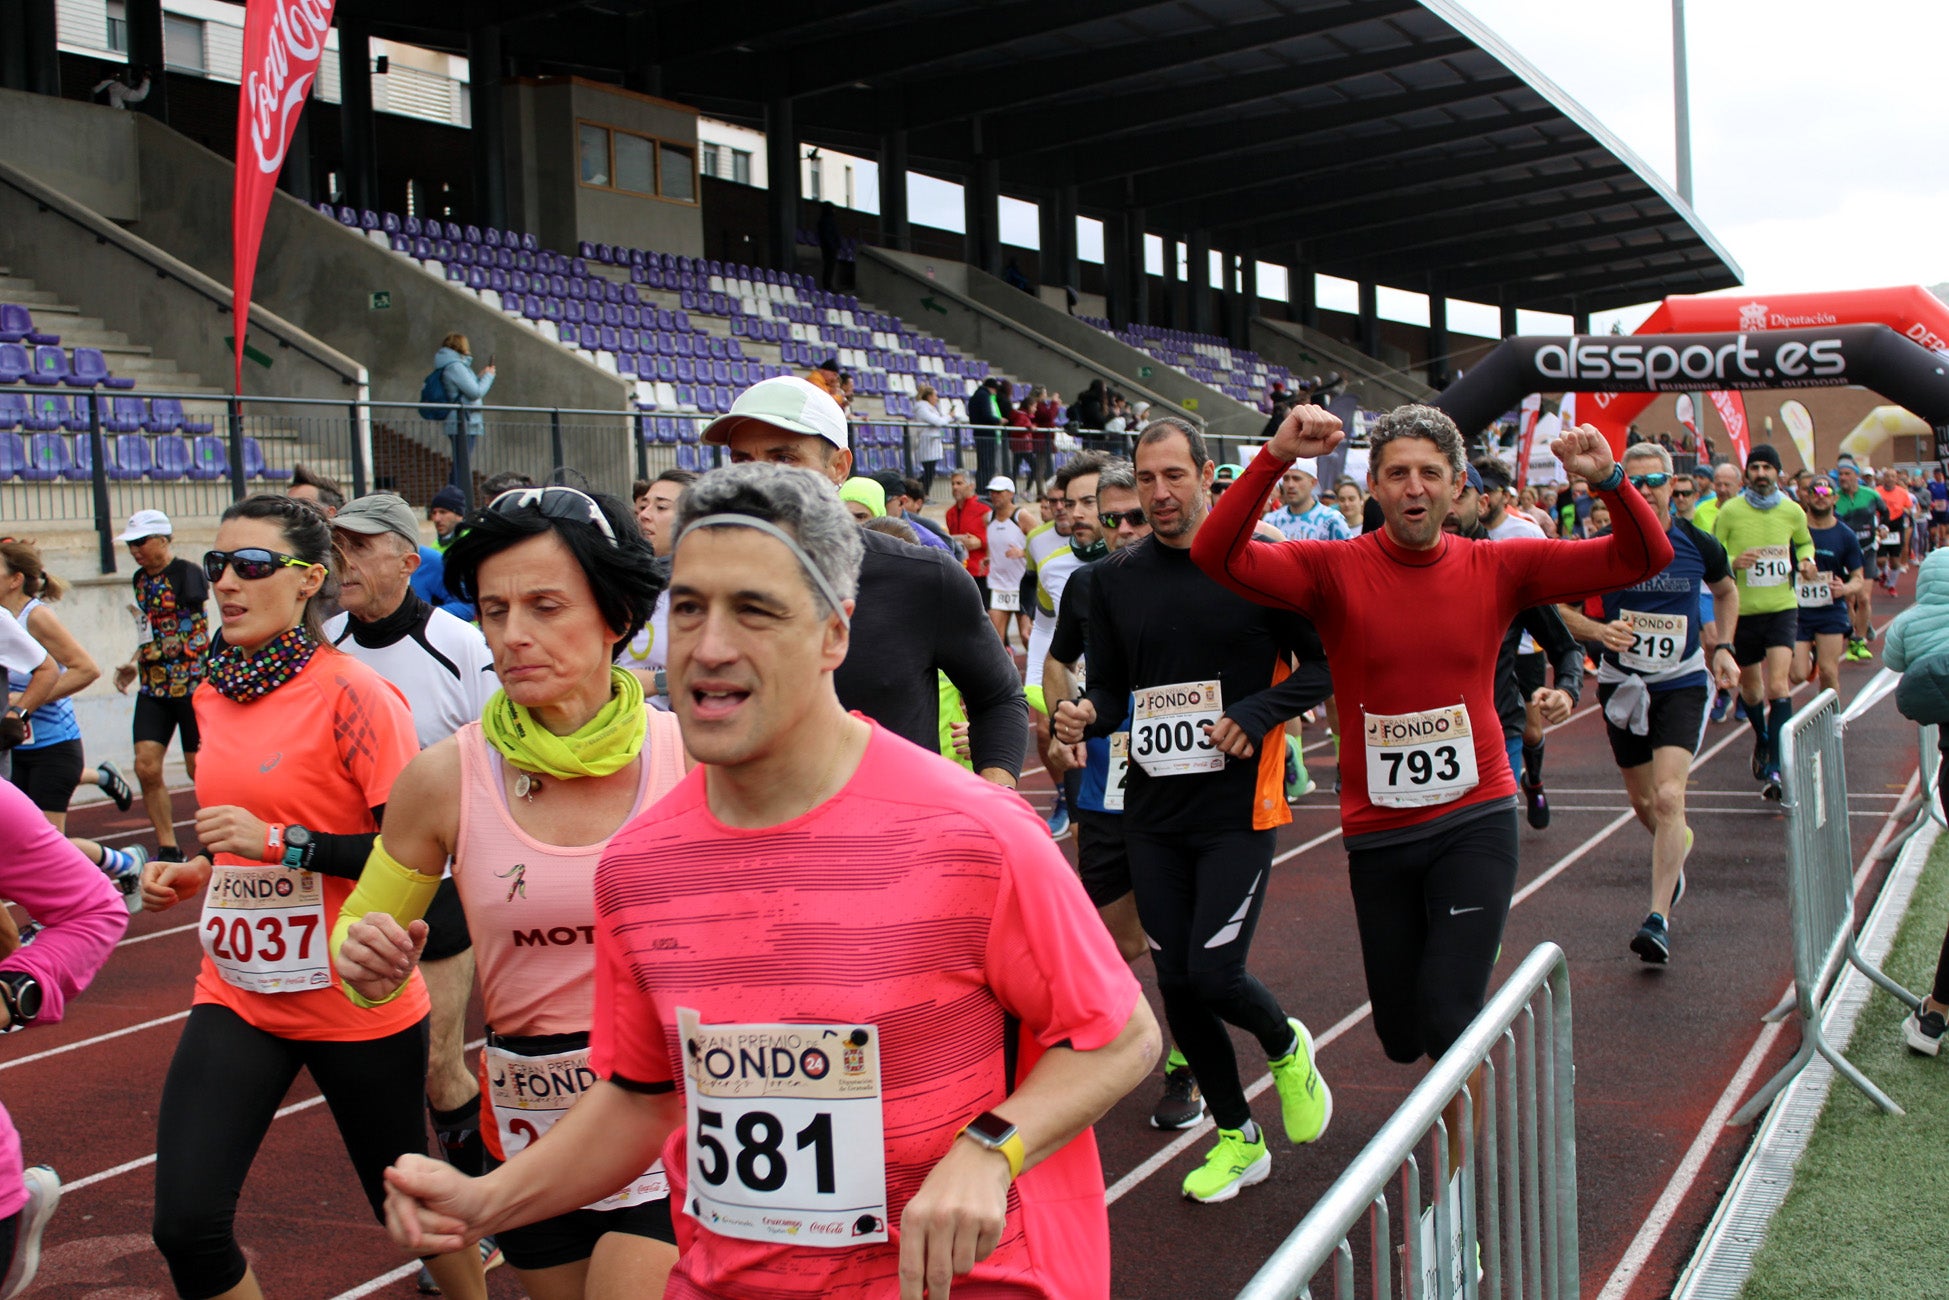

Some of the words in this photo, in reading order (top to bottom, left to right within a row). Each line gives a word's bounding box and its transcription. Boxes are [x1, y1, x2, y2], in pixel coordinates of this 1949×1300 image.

[1770, 311, 1837, 328] Diputación
[1534, 333, 1847, 391] alssport.es
[1660, 381, 1721, 391] RUNNING
[1730, 380, 1768, 389] TRAIL
[1754, 560, 1786, 577] 510
[1801, 585, 1829, 599] 815
[1633, 616, 1674, 630] FONDO
[1627, 632, 1675, 659] 219
[1149, 691, 1201, 710] FONDO
[1137, 718, 1215, 757] 3003
[1384, 718, 1450, 739] FONDO
[1379, 745, 1462, 786] 793
[224, 877, 294, 898] FONDO
[206, 913, 320, 963] 2037
[513, 926, 596, 947] MOT
[738, 1033, 801, 1049] PREMIO
[703, 1047, 830, 1080] ONDO
[806, 1056, 824, 1070] 24
[514, 1067, 597, 1097] FOND
[697, 1107, 836, 1194] 581
